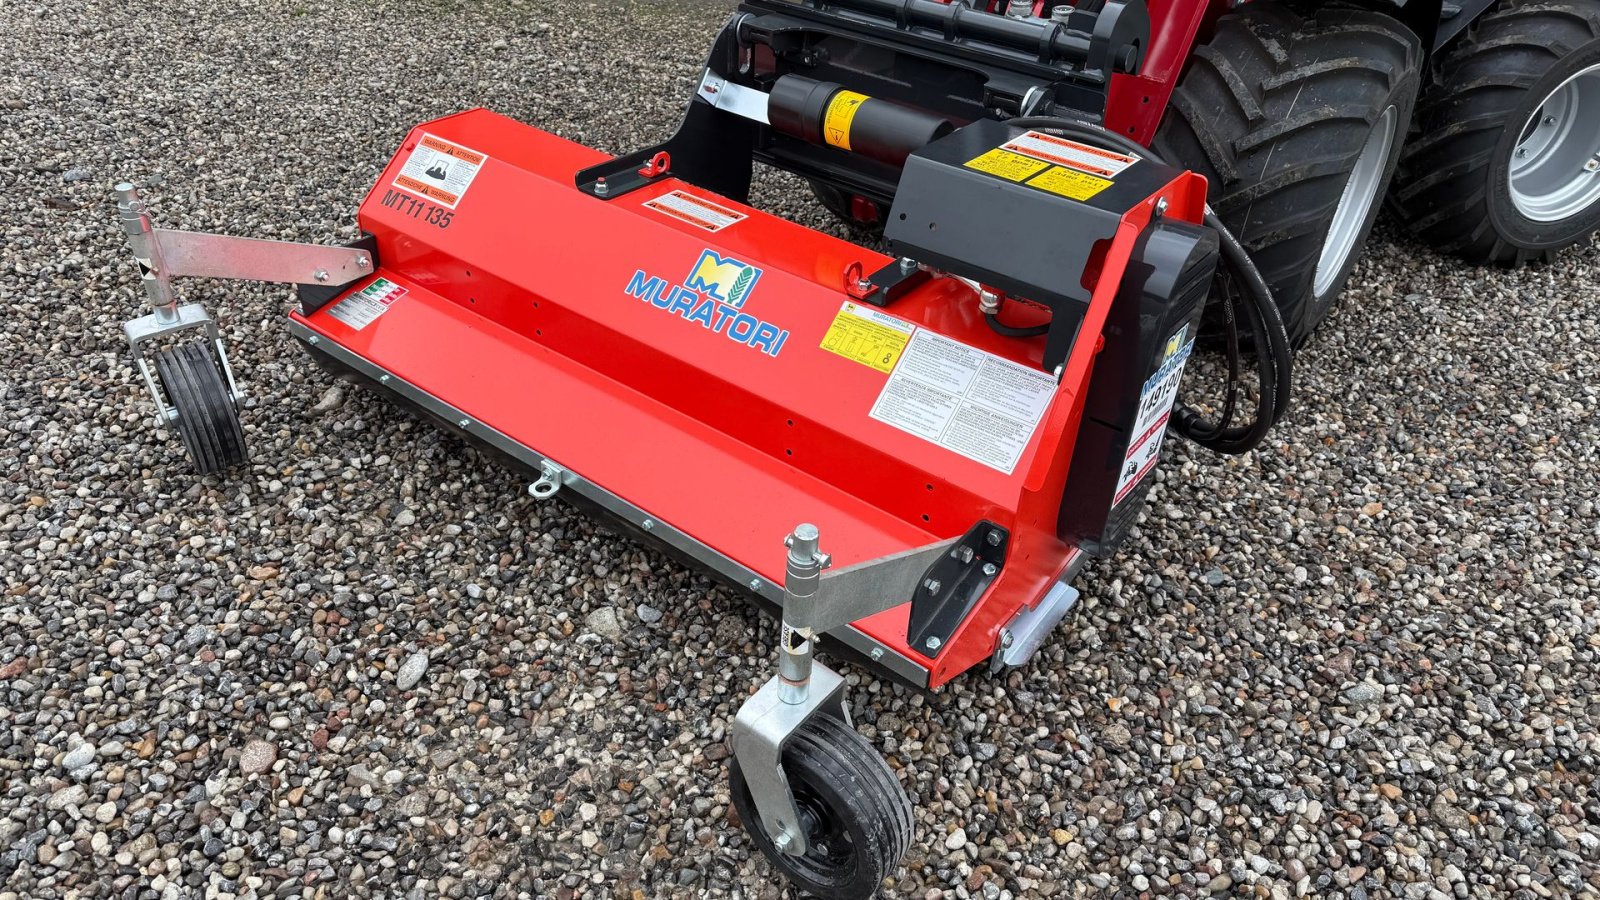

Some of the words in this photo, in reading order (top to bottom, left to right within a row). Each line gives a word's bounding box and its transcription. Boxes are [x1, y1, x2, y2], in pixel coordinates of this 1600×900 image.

[380, 189, 426, 219] MT11
[424, 205, 456, 229] 135
[625, 269, 790, 357] MURATORI
[1140, 366, 1183, 419] 149190
